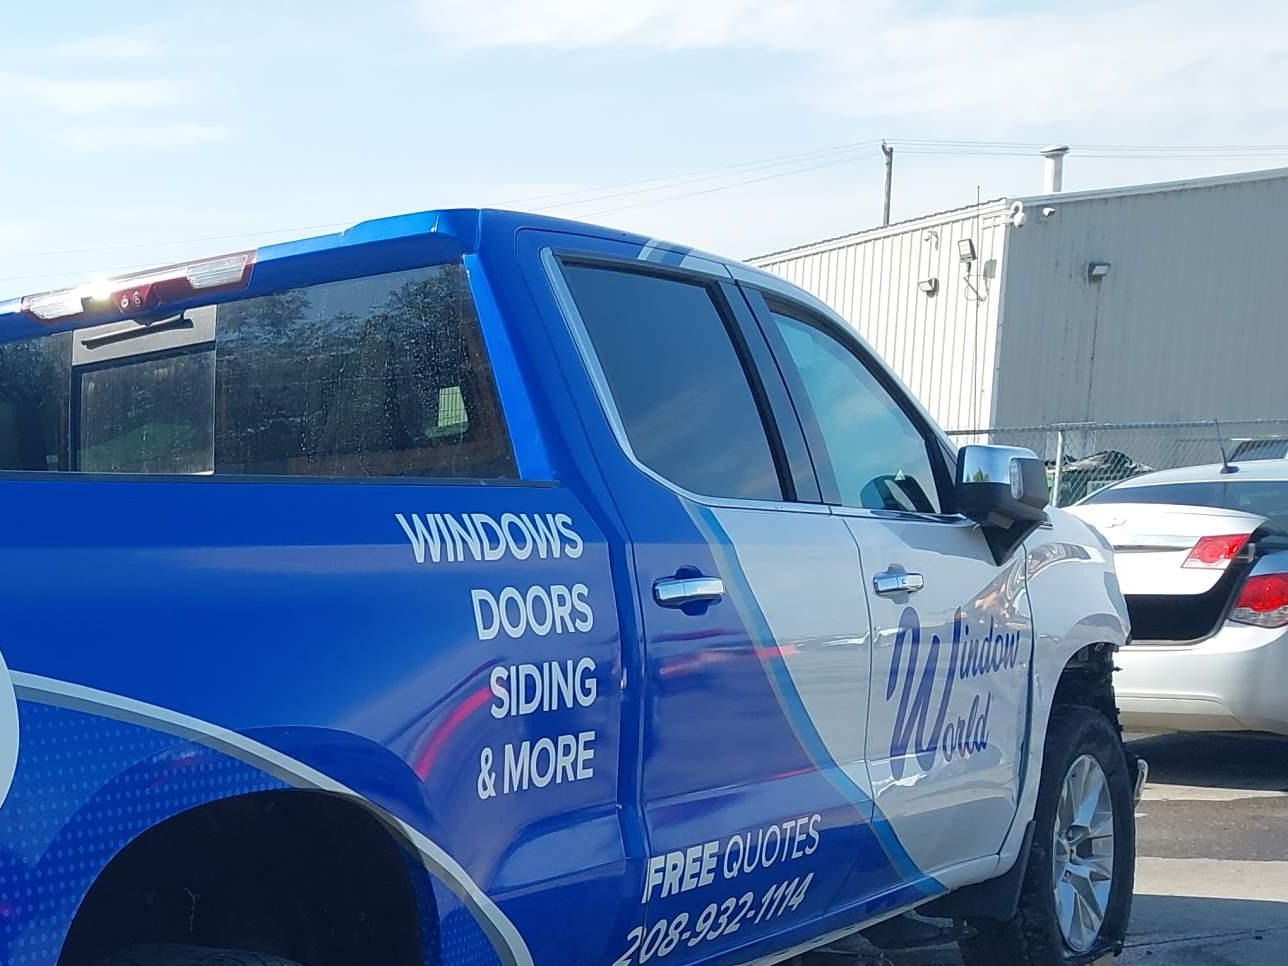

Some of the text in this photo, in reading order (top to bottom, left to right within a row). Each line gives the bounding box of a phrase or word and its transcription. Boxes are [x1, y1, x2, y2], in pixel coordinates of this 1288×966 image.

[394, 513, 584, 564] WINDOWS
[471, 583, 594, 640] DOORS
[489, 657, 597, 719] SIDING
[887, 606, 1020, 780] Window
[477, 731, 596, 800] & MORE
[641, 814, 822, 904] FREE QUOTES
